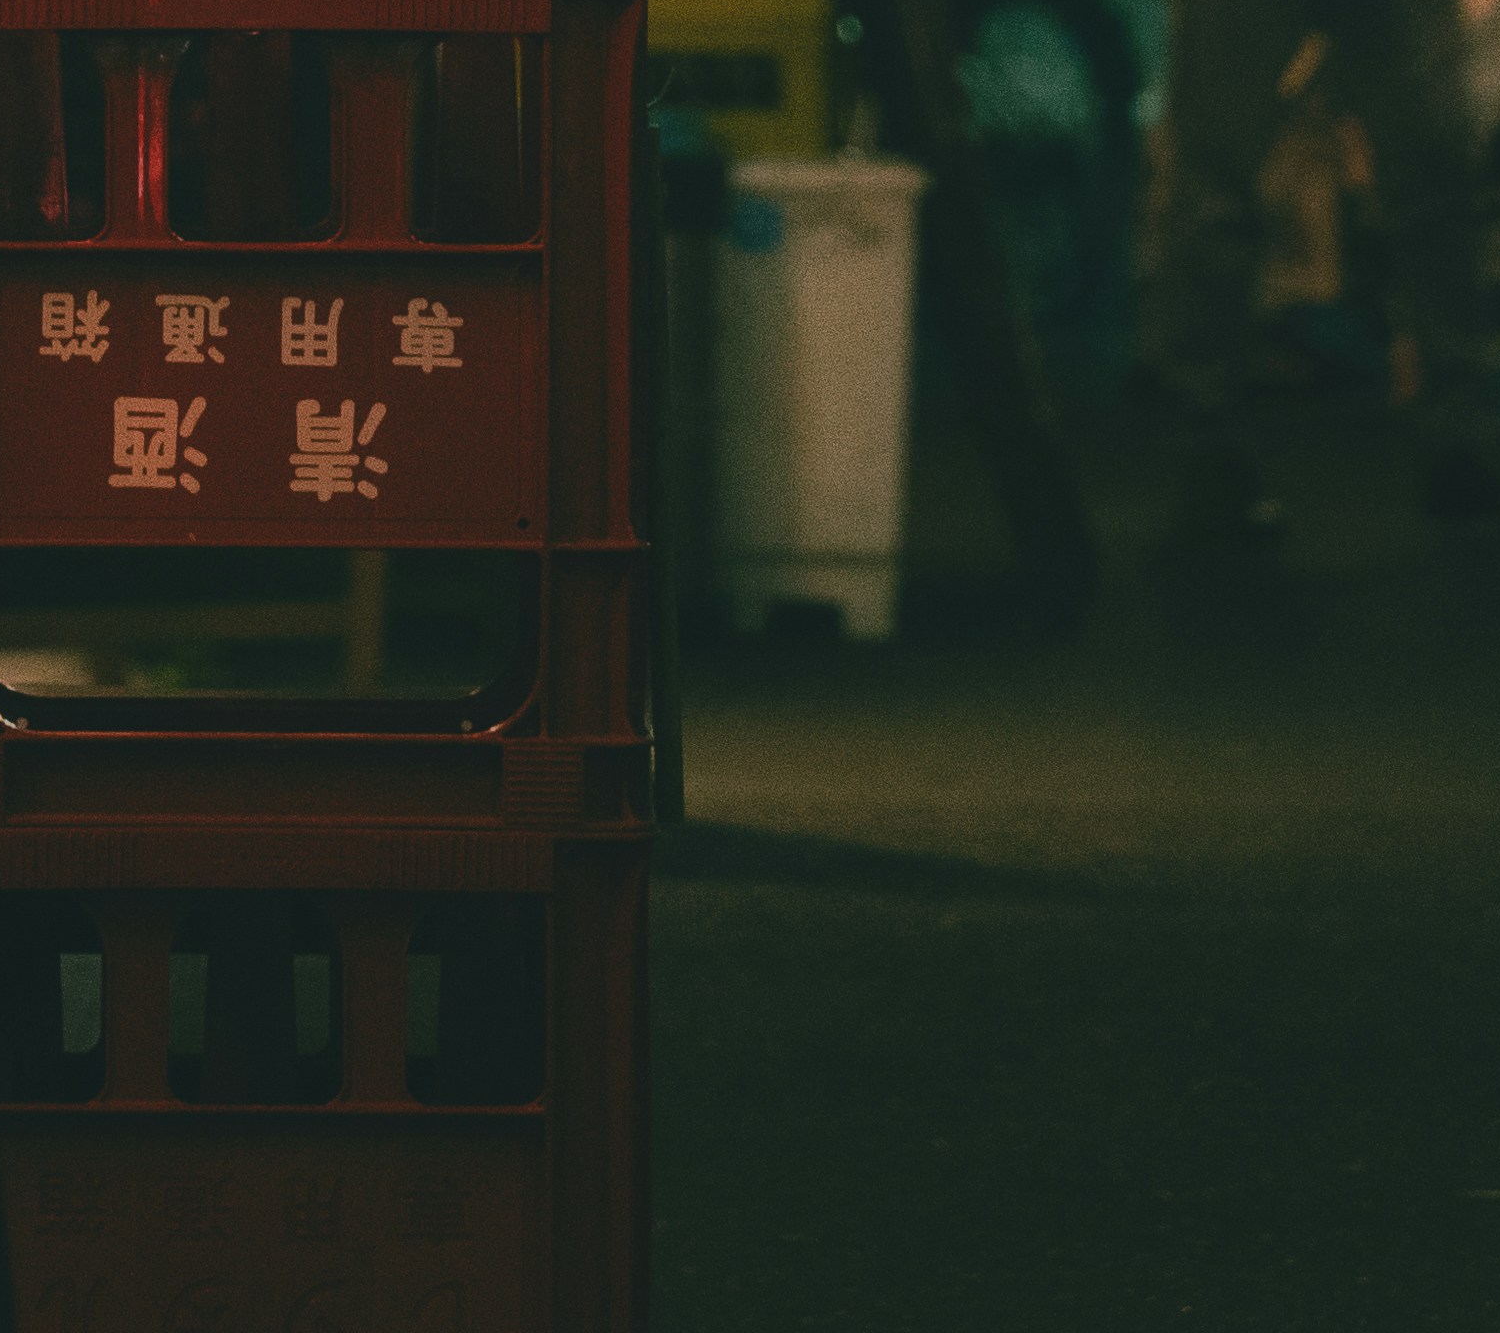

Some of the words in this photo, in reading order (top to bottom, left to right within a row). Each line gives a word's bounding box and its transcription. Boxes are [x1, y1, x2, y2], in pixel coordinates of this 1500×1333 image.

[38, 289, 464, 373] 専用通箱
[107, 395, 389, 503] 清酒
